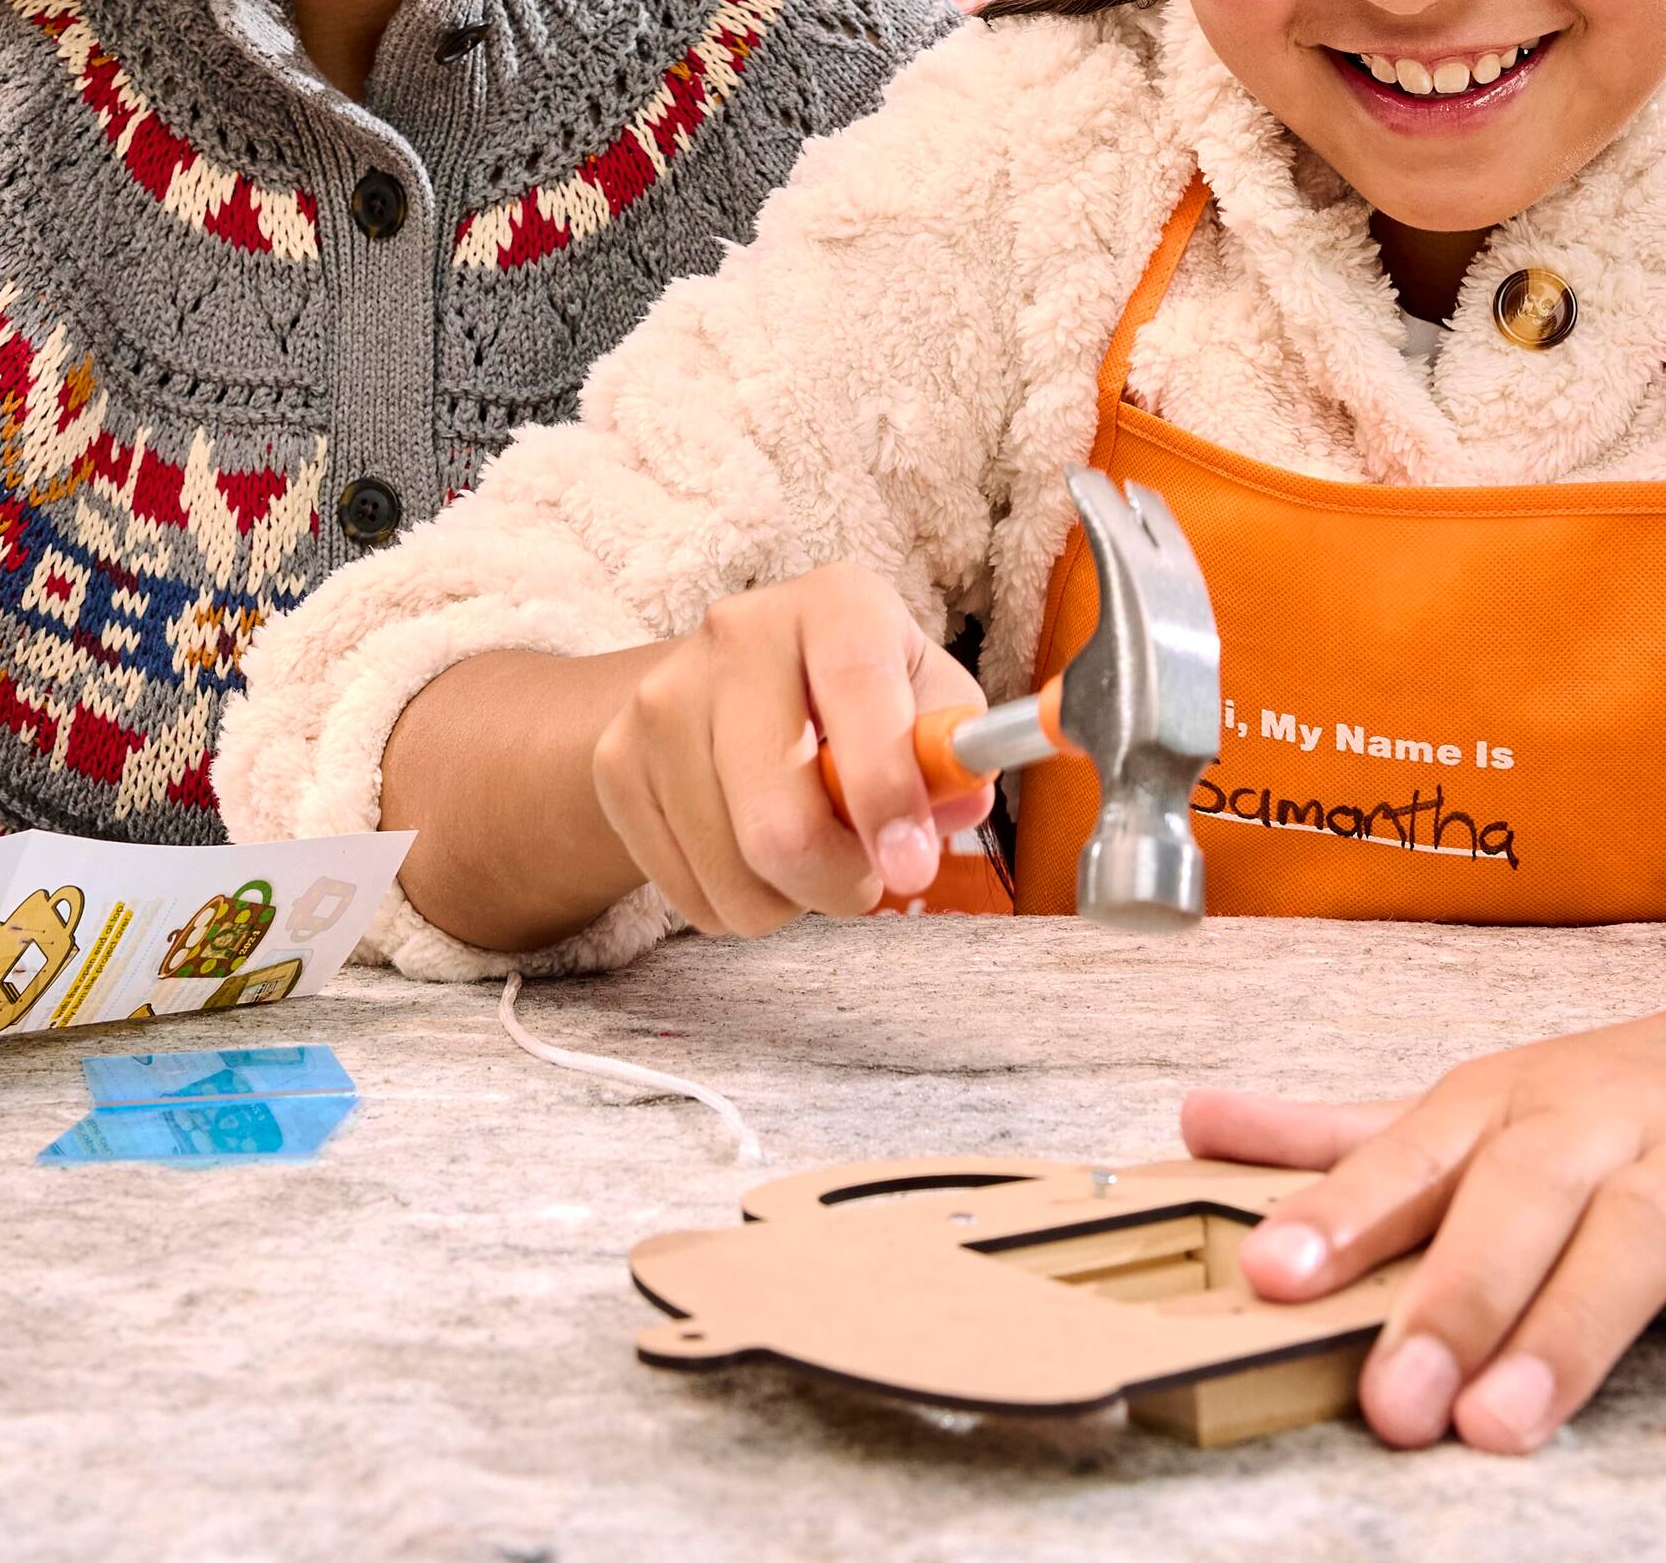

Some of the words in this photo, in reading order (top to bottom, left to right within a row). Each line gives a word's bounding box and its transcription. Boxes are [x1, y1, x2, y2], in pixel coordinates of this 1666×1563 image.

[1261, 708, 1323, 752] My
[1336, 723, 1462, 766] Name
[1476, 741, 1515, 770] Is
